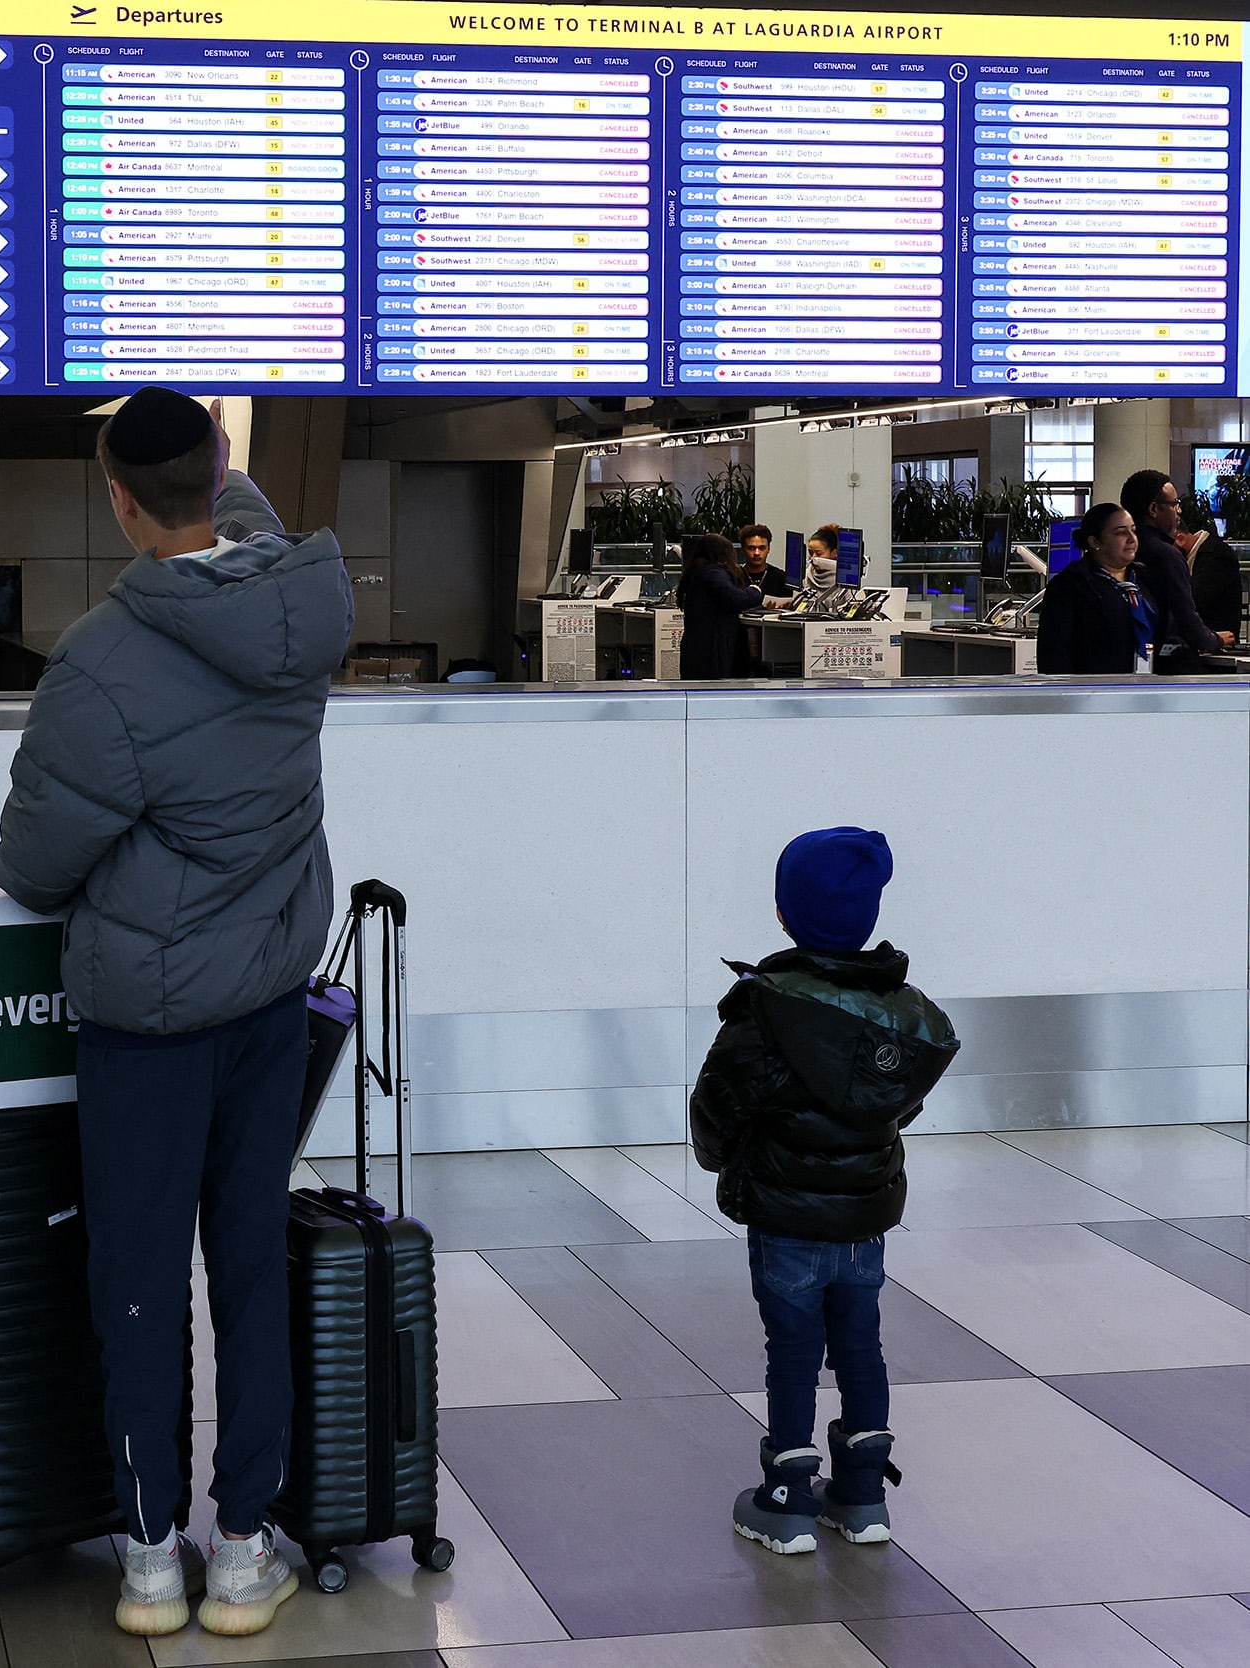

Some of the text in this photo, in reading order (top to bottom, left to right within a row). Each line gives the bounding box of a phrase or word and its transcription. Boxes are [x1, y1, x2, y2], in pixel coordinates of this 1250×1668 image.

[116, 7, 223, 26] Departures
[450, 16, 943, 40] WELCOME TO TERMINAL B AT LAGUARDIA AIRPORT
[1168, 33, 1229, 47] 1:10 PM
[733, 82, 772, 90] Southwest
[118, 162, 130, 170] Air
[133, 163, 162, 171] Canada
[430, 234, 471, 243] Southwest
